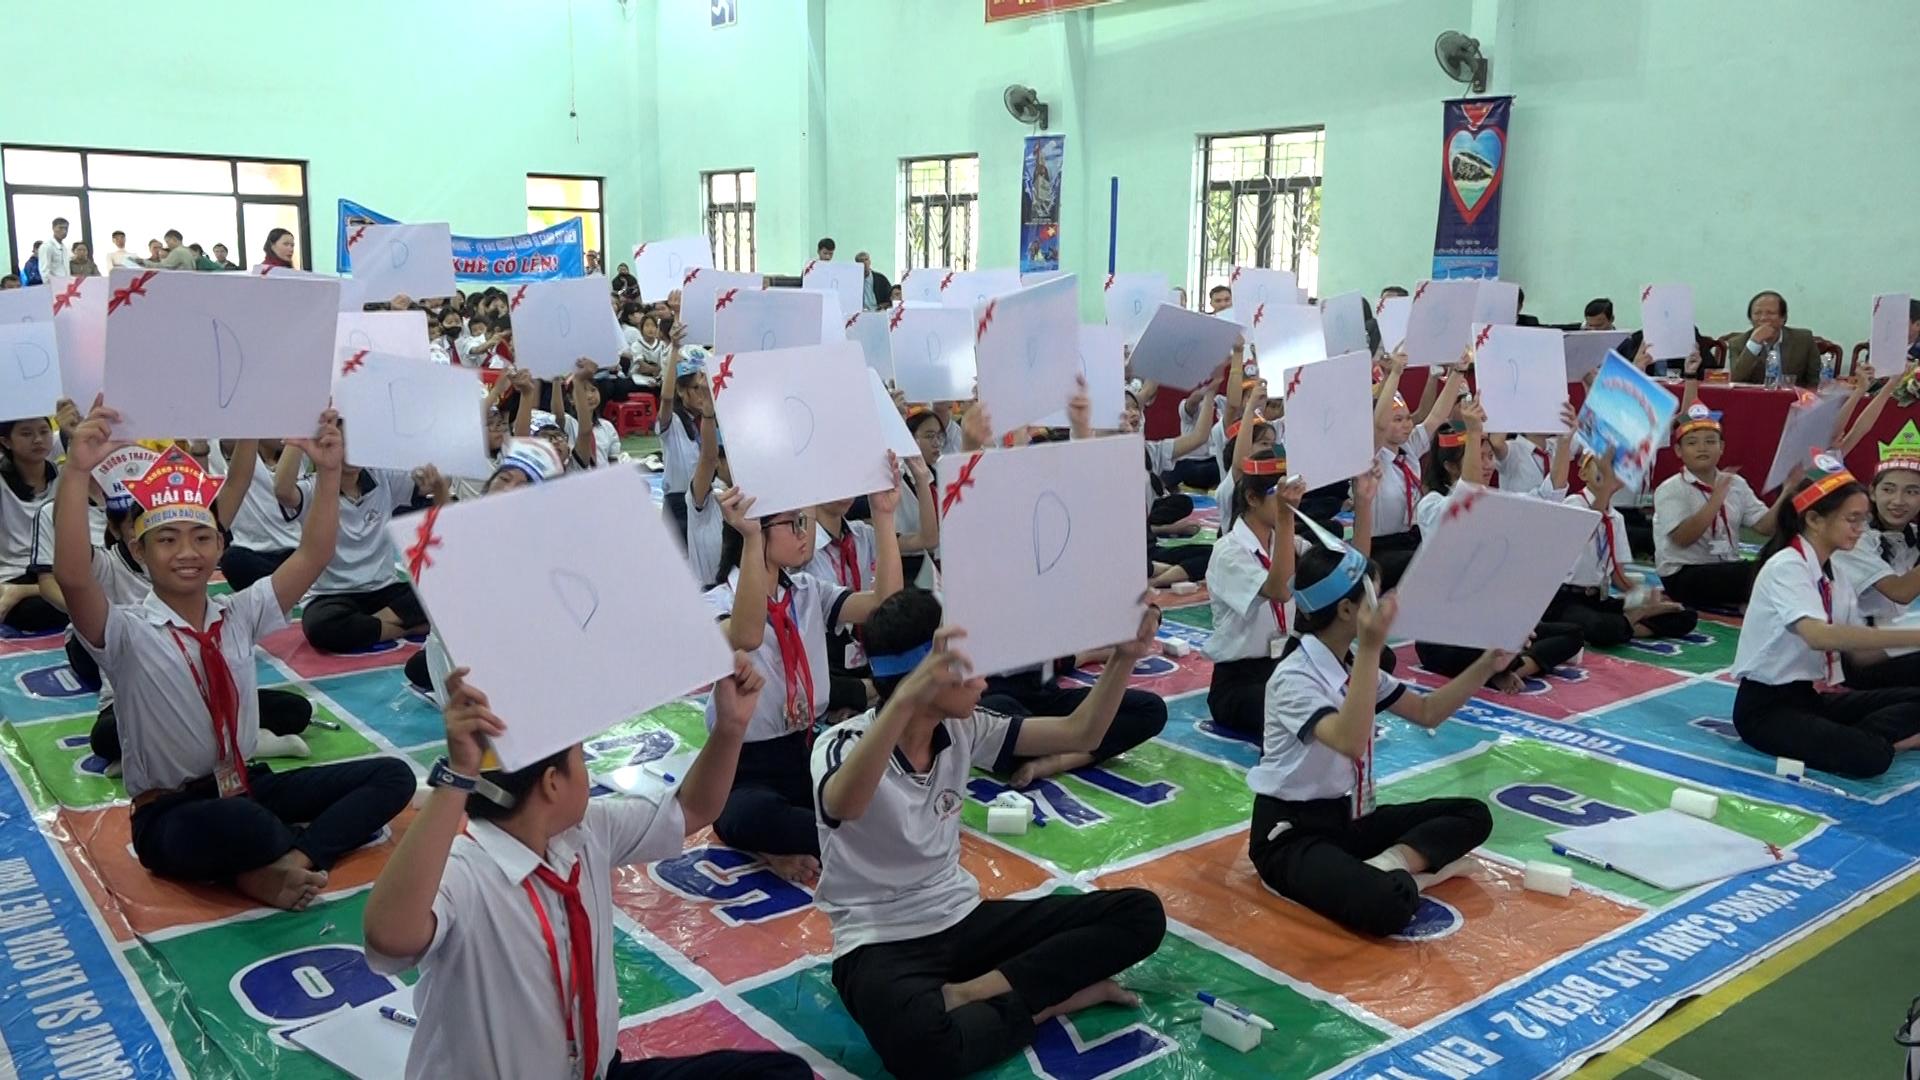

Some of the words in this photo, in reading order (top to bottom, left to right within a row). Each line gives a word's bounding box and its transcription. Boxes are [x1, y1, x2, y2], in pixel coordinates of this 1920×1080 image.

[493, 252, 517, 274] CỐ
[521, 252, 559, 274] LÊN!
[13, 342, 50, 381] D
[212, 318, 243, 408] D
[783, 396, 815, 457] D
[1032, 490, 1070, 576] D
[547, 567, 600, 631] D
[1586, 949, 1670, 989] SÁT
[32, 990, 103, 1030] SA
[1515, 974, 1618, 1026] BIỂN
[1488, 1010, 1548, 1040] 2
